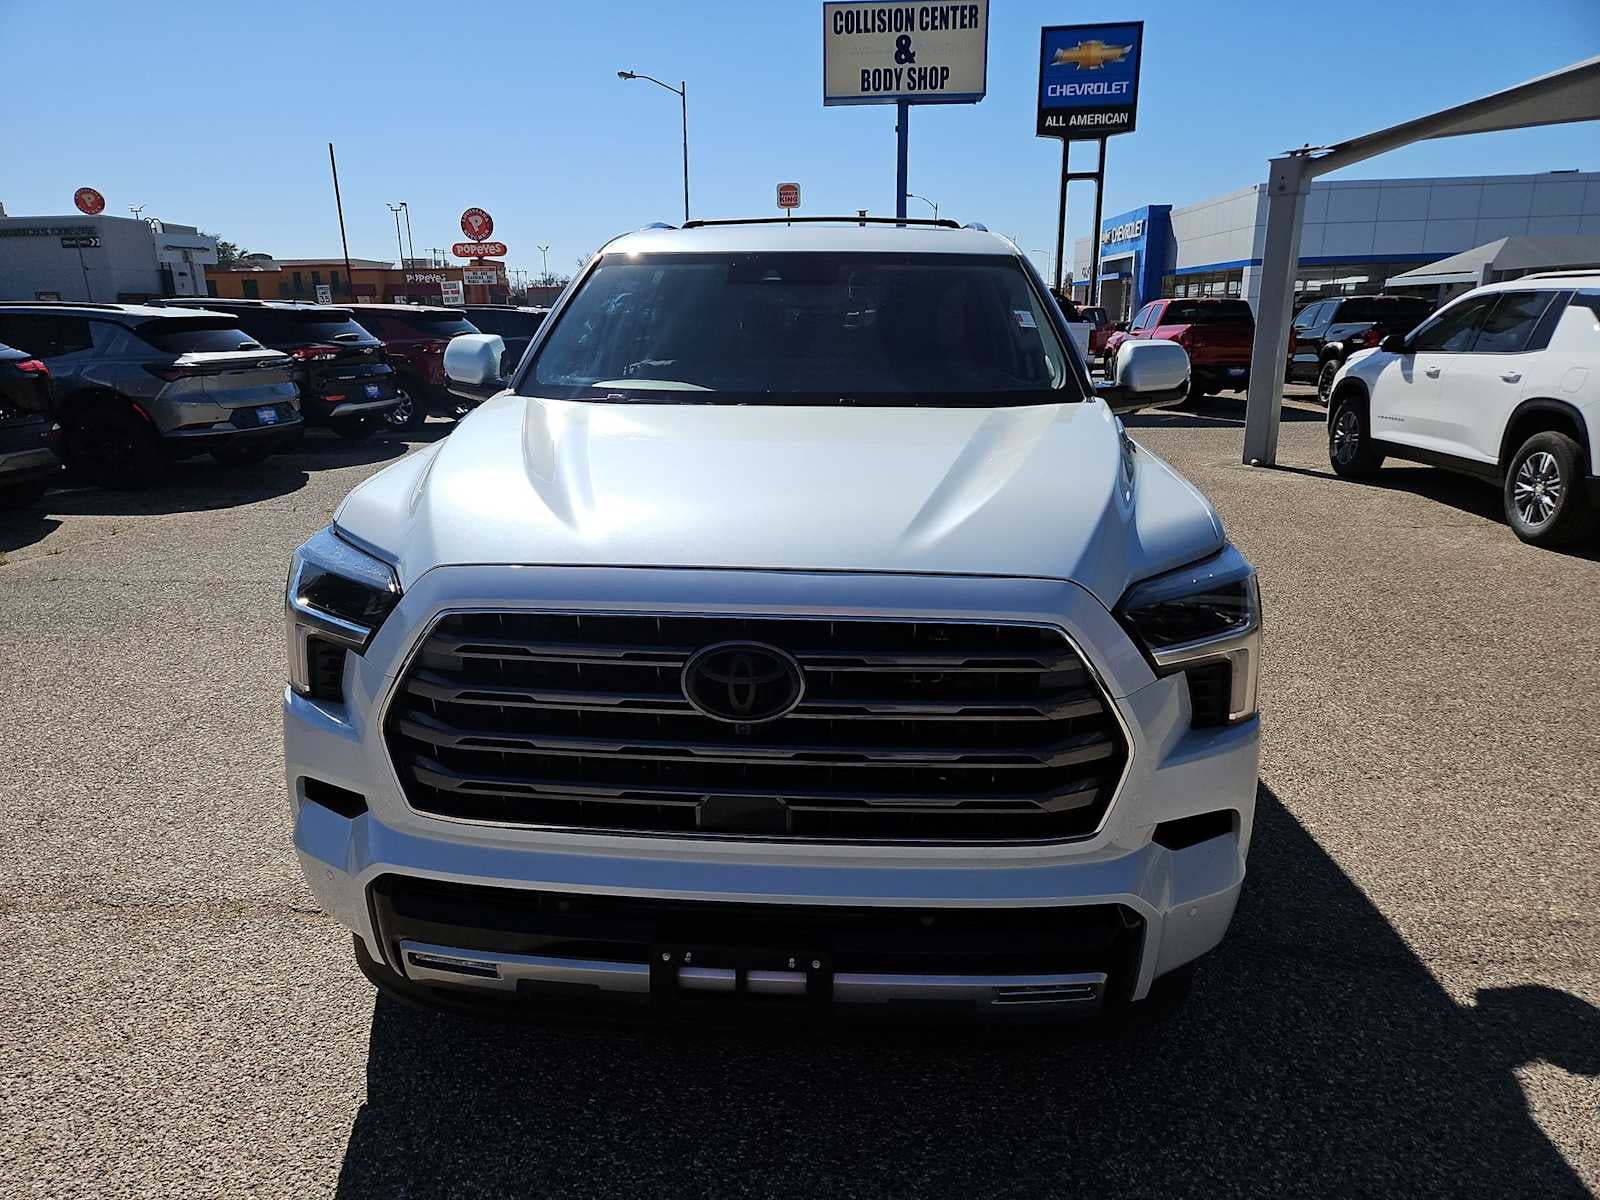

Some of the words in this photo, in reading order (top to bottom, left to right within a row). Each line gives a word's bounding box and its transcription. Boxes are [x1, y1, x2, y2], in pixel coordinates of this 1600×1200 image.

[833, 8, 915, 35] COLLISION
[919, 5, 979, 32] CENTER
[894, 34, 916, 65] &
[860, 68, 904, 92] BODY
[906, 66, 950, 91] SHOP
[1047, 81, 1130, 97] CHEVROLET
[1045, 115, 1066, 127] ALL
[1069, 113, 1129, 126] AMERICAN
[1111, 219, 1144, 243] CHEVROLET
